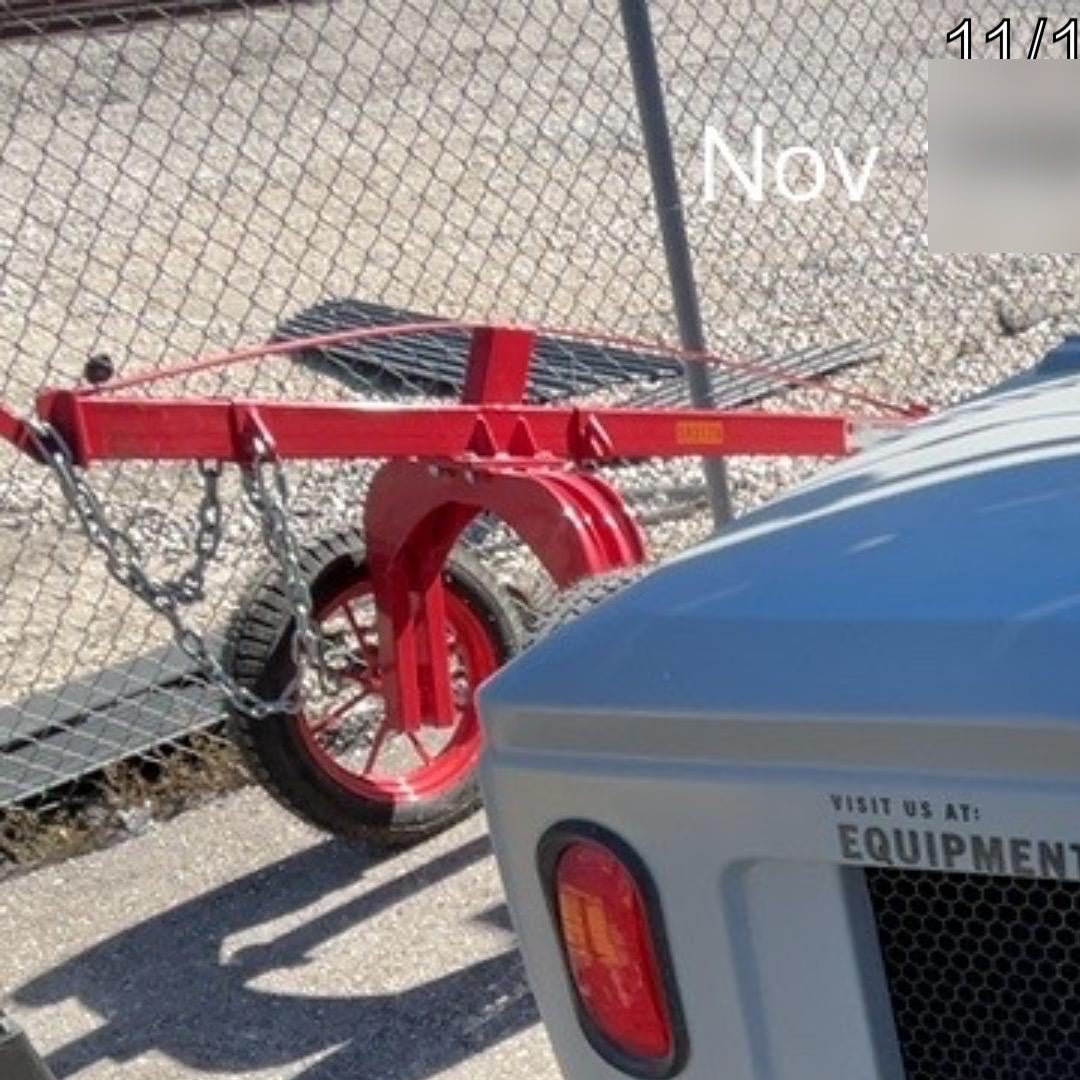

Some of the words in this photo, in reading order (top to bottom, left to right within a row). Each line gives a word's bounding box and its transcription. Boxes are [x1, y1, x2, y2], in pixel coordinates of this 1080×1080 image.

[830, 794, 892, 816] VISIT
[903, 800, 933, 820] US
[943, 802, 982, 822] AT:
